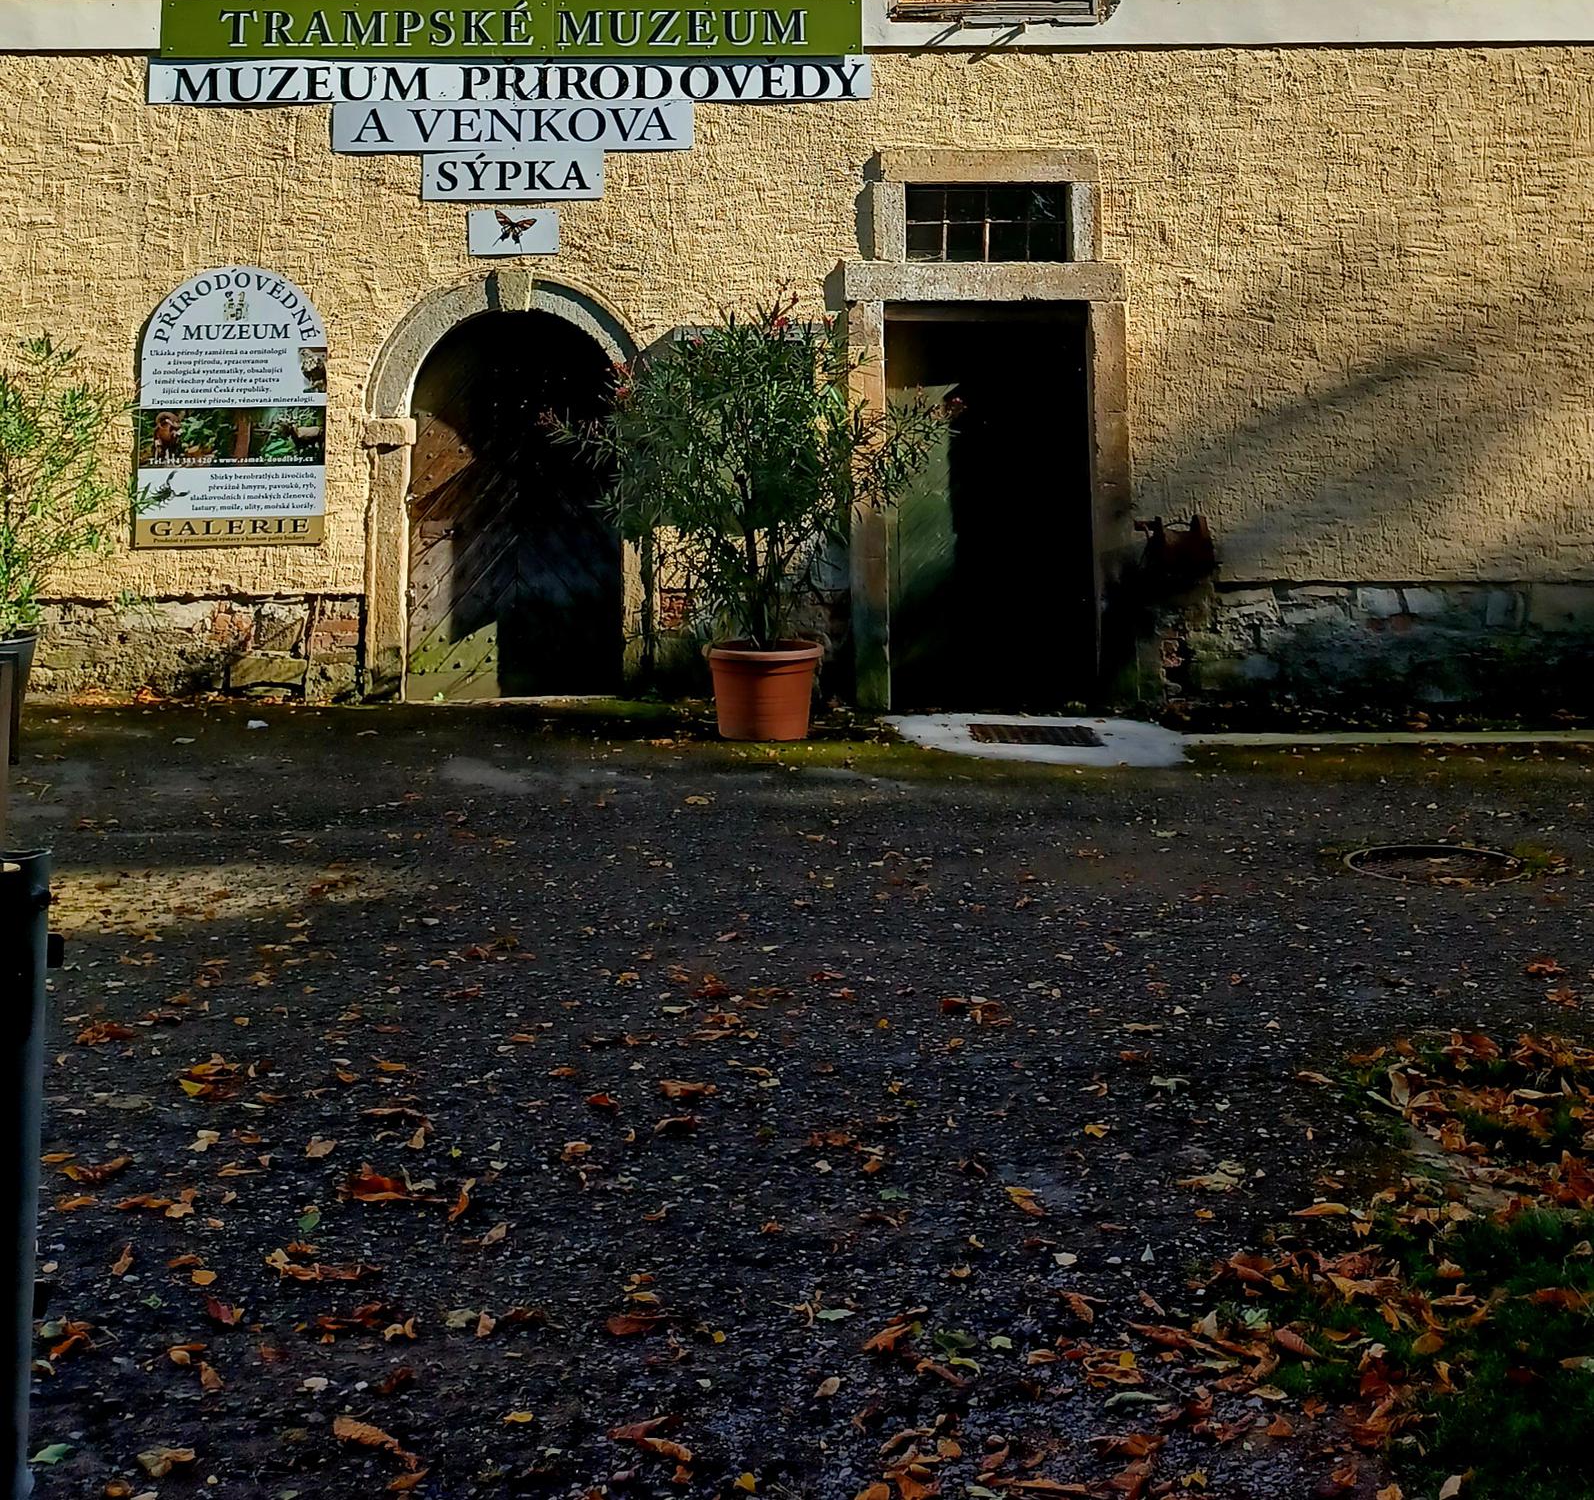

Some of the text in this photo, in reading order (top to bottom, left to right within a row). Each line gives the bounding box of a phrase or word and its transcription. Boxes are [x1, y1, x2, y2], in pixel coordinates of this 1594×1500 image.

[218, 0, 808, 47] TRAMPSKÉ MUZEUM
[171, 57, 864, 102] MUZEUM PŘÍRODOVĚDY
[350, 106, 677, 143] A VENKOVA
[436, 152, 591, 191] SÝPKA
[153, 271, 320, 344] PŘÍRODOVĚDNÉ
[182, 323, 291, 341] MUZEUM
[150, 519, 309, 536] GALERIE
